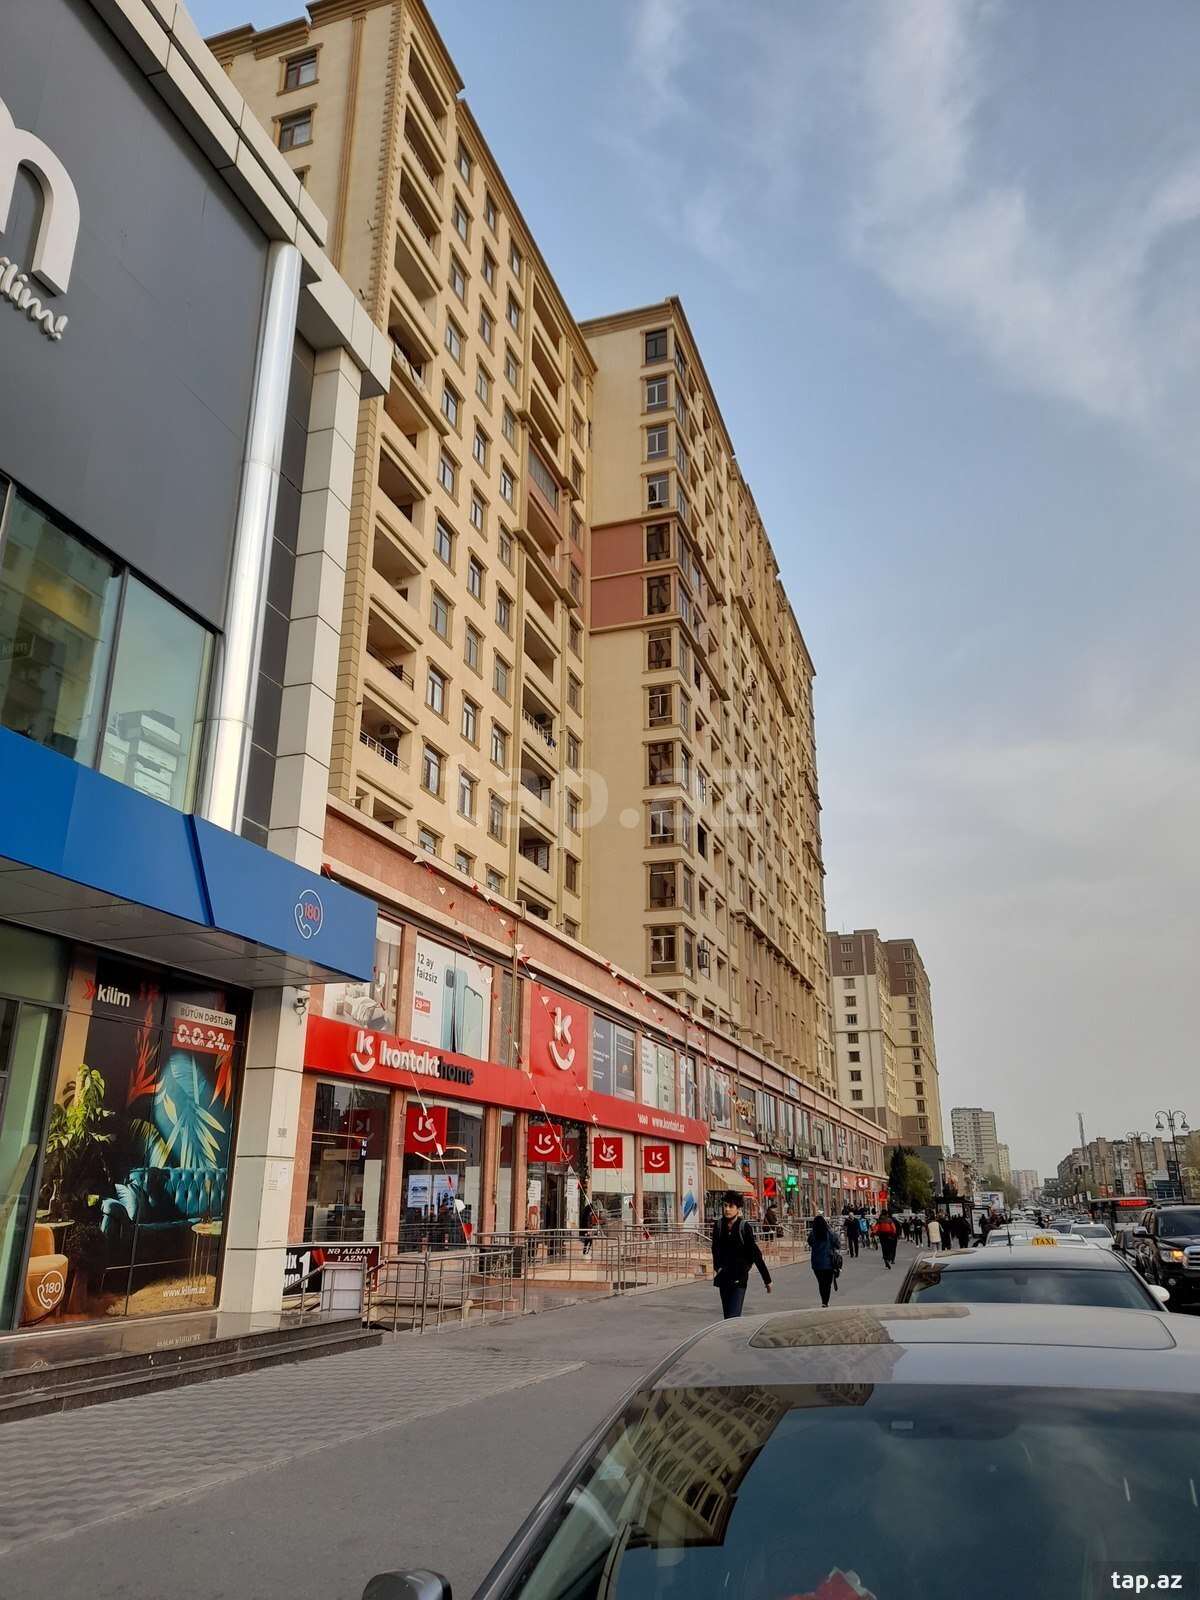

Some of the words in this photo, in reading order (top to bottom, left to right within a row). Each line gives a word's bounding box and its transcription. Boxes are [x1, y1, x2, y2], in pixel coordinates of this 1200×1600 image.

[304, 902, 320, 922] 180
[417, 952, 425, 964] 12
[426, 958, 435, 970] ay
[416, 966, 438, 984] faizsiz
[97, 984, 131, 1008] kilim
[180, 1007, 204, 1020] BÜTÜN
[1034, 1238, 1056, 1246] TAXI
[44, 1281, 61, 1294] 180
[162, 1286, 207, 1298] www.kilim.az
